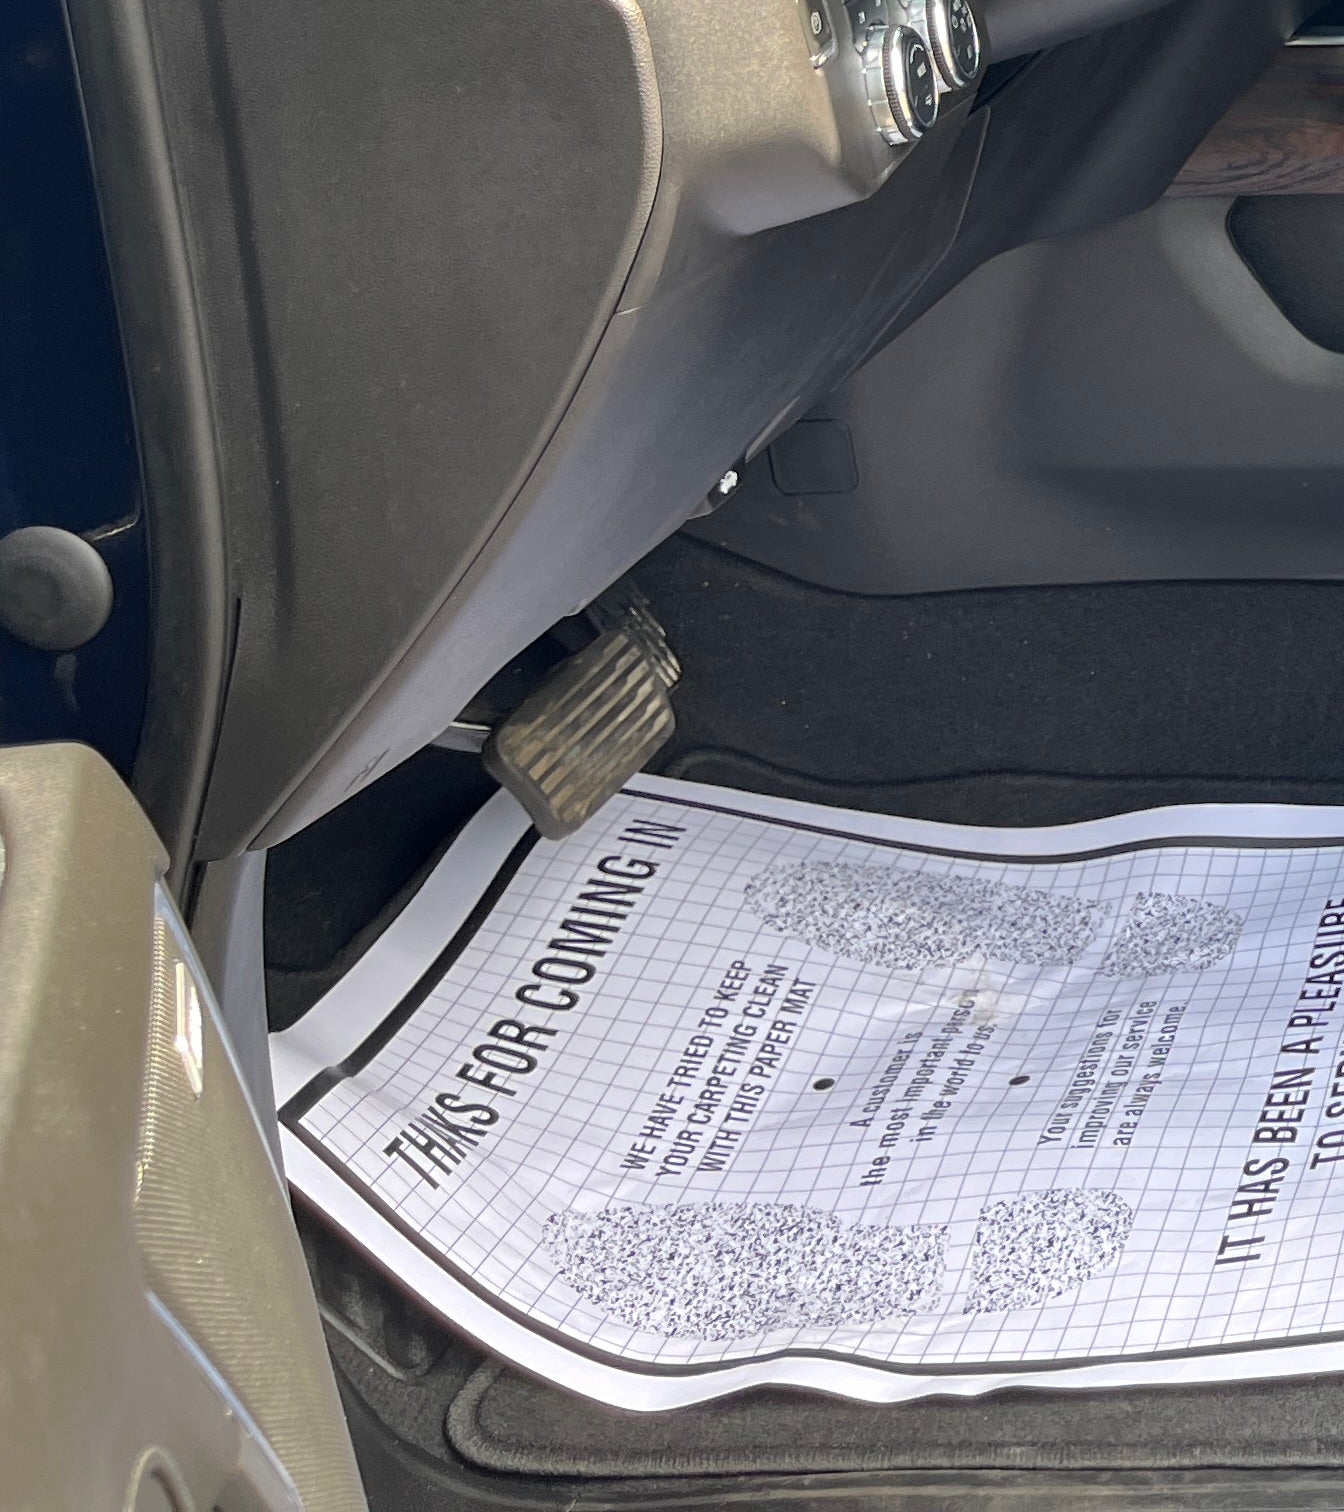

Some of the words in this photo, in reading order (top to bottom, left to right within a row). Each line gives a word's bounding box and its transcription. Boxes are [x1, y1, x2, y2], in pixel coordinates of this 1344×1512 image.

[455, 1019, 558, 1097] FOR
[515, 855, 659, 1011] COMING
[617, 819, 688, 850] IN
[713, 960, 752, 1002] KEEP
[698, 1006, 729, 1028] TO
[973, 1023, 998, 1041] us.
[1122, 1000, 1158, 1050] service
[1147, 1001, 1190, 1068] welcome.
[667, 1034, 714, 1088] TRIED
[959, 1042, 985, 1055] to
[1110, 1054, 1135, 1077] our
[1279, 1035, 1324, 1054] A
[655, 1129, 704, 1177] YOUR
[687, 1023, 757, 1125] CARPETING
[742, 963, 789, 1019] CLEAN
[697, 1129, 742, 1173] WITH
[724, 1082, 766, 1123] THIS
[749, 1019, 797, 1079] PAPER
[780, 977, 817, 1015] MAT
[849, 1116, 874, 1127] A
[862, 1046, 914, 1113] customer
[897, 1030, 923, 1045] is
[895, 1036, 954, 1102] important
[939, 1057, 976, 1097] world
[1036, 1112, 1073, 1146] Your
[1060, 1031, 1113, 1109] suggestions
[1096, 1009, 1123, 1028] for
[639, 1093, 685, 1139] HAVE
[920, 1100, 952, 1120] the
[1070, 1080, 1129, 1149] improving
[1122, 1072, 1163, 1117] always
[1252, 1067, 1316, 1144] BEEN
[879, 1105, 914, 1148] most
[909, 1125, 938, 1143] in
[1113, 1121, 1138, 1147] are
[619, 1142, 656, 1170] WE
[859, 1155, 891, 1186] the
[1227, 1157, 1290, 1221] HAS
[1214, 1234, 1266, 1266] IT
